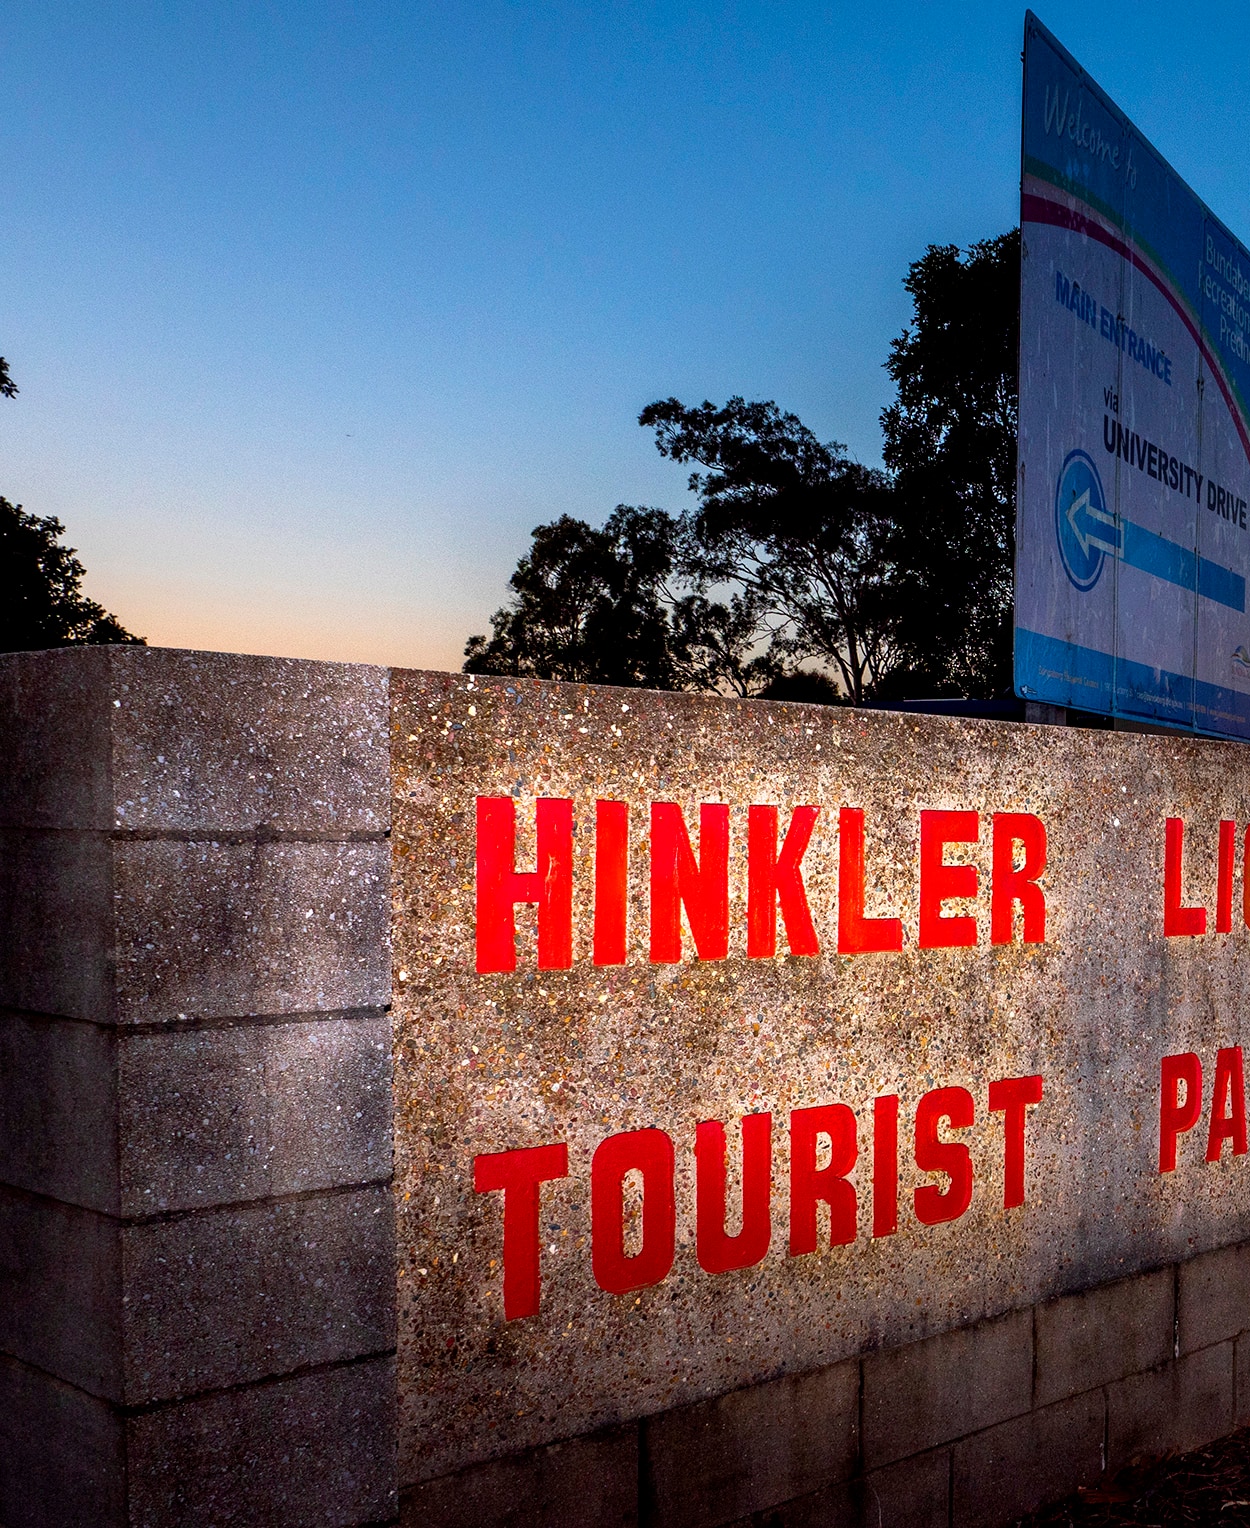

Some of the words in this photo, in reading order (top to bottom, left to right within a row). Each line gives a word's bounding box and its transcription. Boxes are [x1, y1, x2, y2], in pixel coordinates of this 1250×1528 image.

[1044, 84, 1120, 169] Welcome
[1126, 148, 1137, 190] to
[1055, 270, 1097, 329] MAIN
[1101, 305, 1172, 386] ENTRANCE
[1103, 386, 1119, 414] via
[1103, 414, 1203, 504] UNIVERSITY
[1207, 479, 1247, 530] DRIVE
[476, 796, 1046, 974] HINKLER
[474, 1075, 1043, 1321] TOURIST
